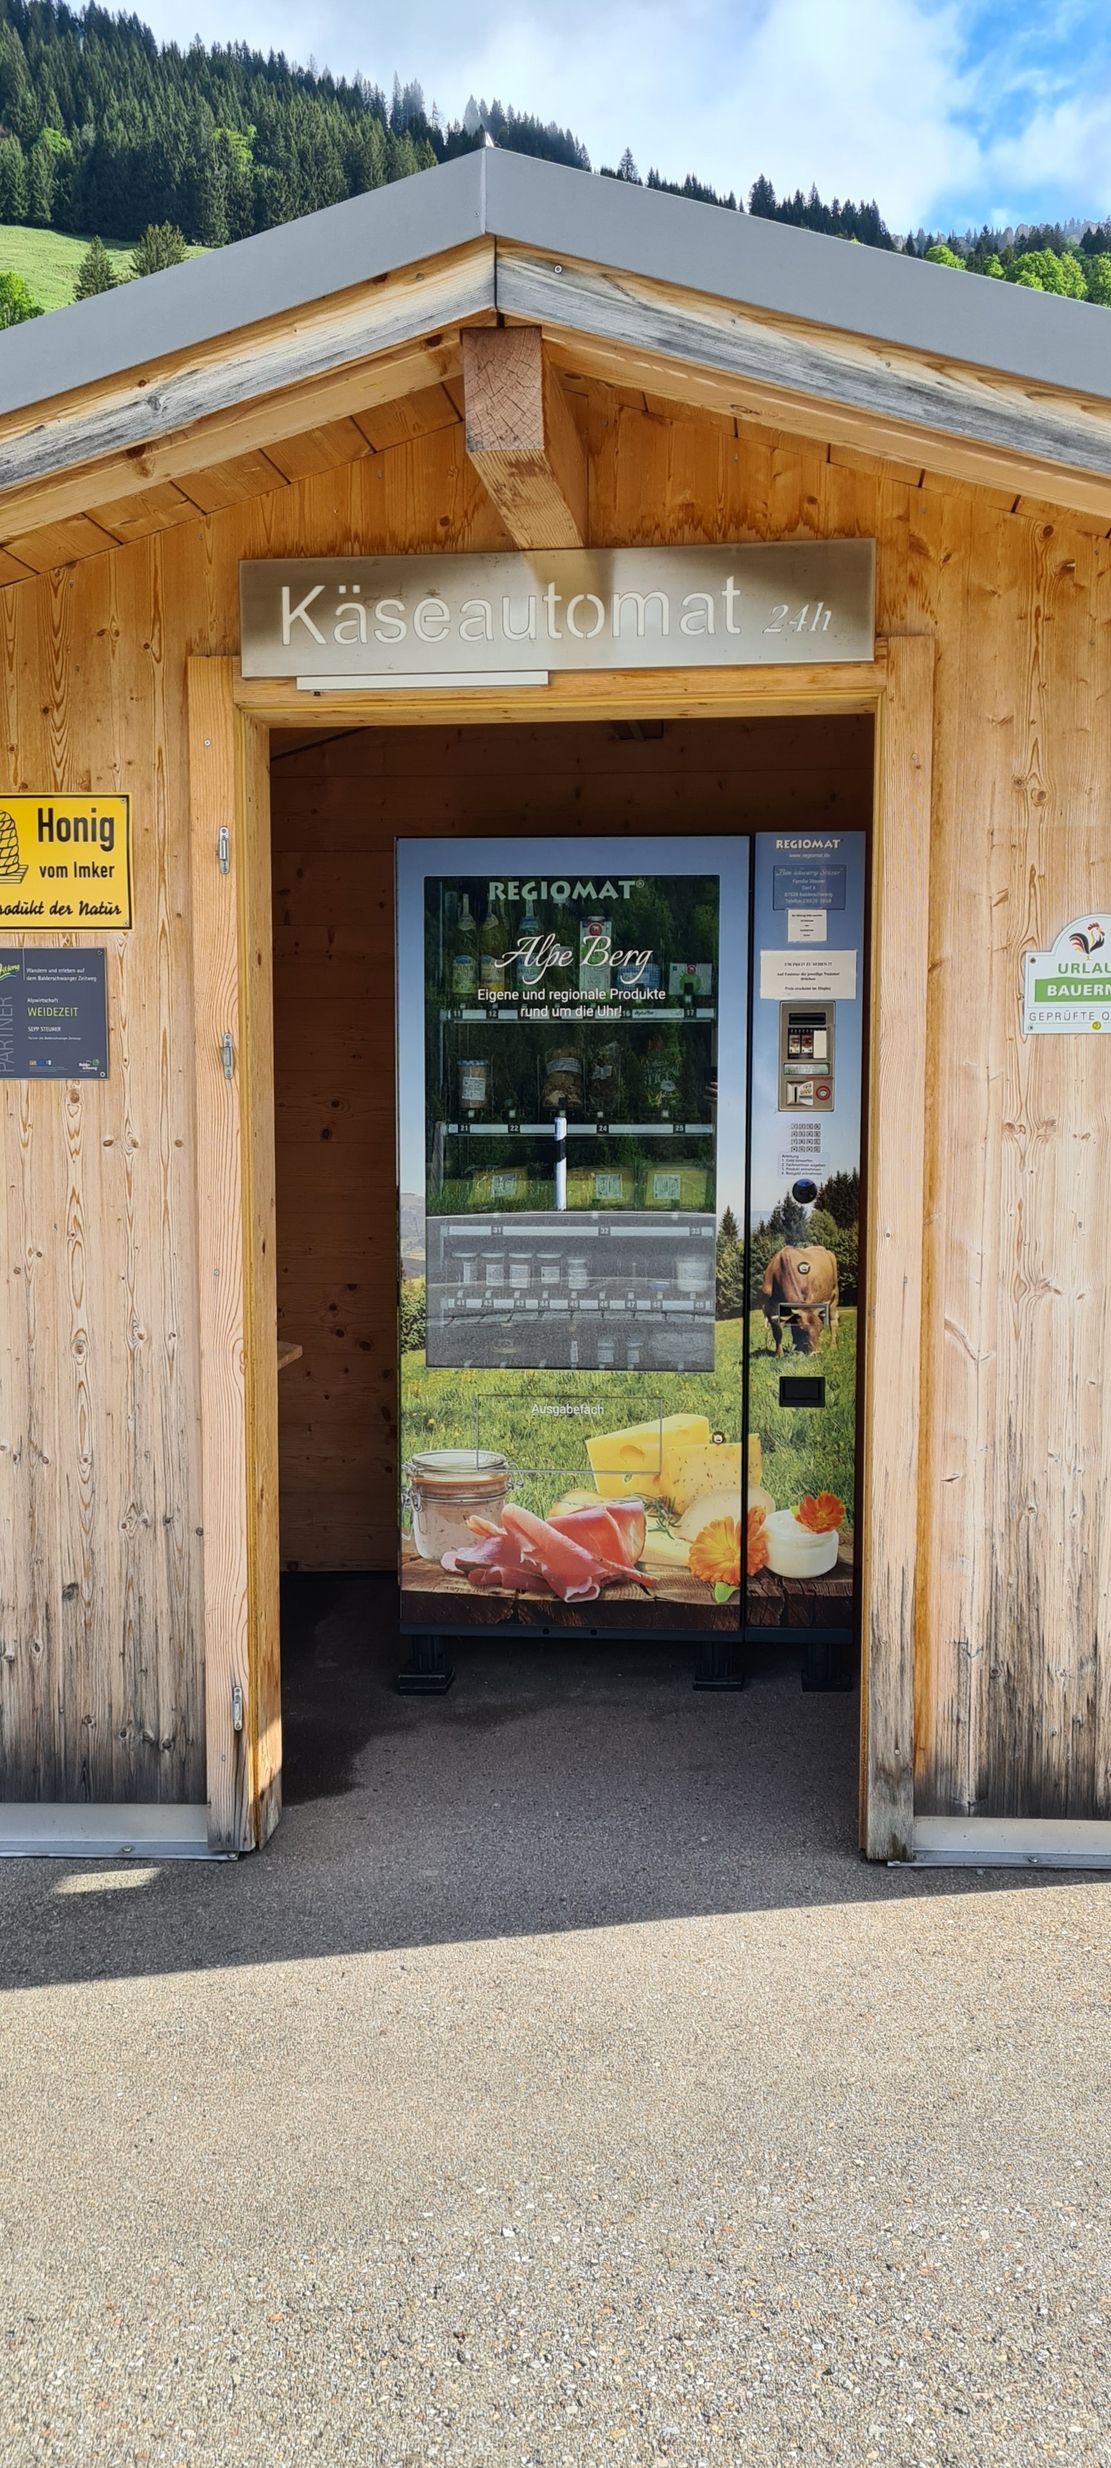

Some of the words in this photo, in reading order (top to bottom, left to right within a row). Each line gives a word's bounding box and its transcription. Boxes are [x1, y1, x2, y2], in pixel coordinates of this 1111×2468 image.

[281, 575, 741, 646] Käseautomat
[762, 601, 833, 635] 24h
[37, 807, 115, 852] Honig
[775, 839, 841, 849] REGIOMAT
[39, 865, 68, 878] vom
[74, 861, 115, 878] Imker
[49, 900, 73, 915] der
[494, 933, 574, 985] Alpe
[580, 935, 653, 985] Berg
[477, 989, 519, 1003] Eigene
[523, 989, 546, 1000] und
[550, 989, 605, 1003] regionale
[610, 988, 666, 1000] Produkte
[27, 1007, 79, 1017] WEIDEZEIT
[520, 1005, 548, 1017] rund
[552, 1008, 572, 1017] um
[575, 1005, 593, 1017] die
[597, 1005, 622, 1017] Uhr!
[1029, 1010, 1095, 1021] GEPRÜFTE
[460, 1124, 468, 1133] 21
[510, 1124, 518, 1133] 22
[598, 1124, 607, 1133] 24
[531, 1403, 605, 1416] Ausgabefach
